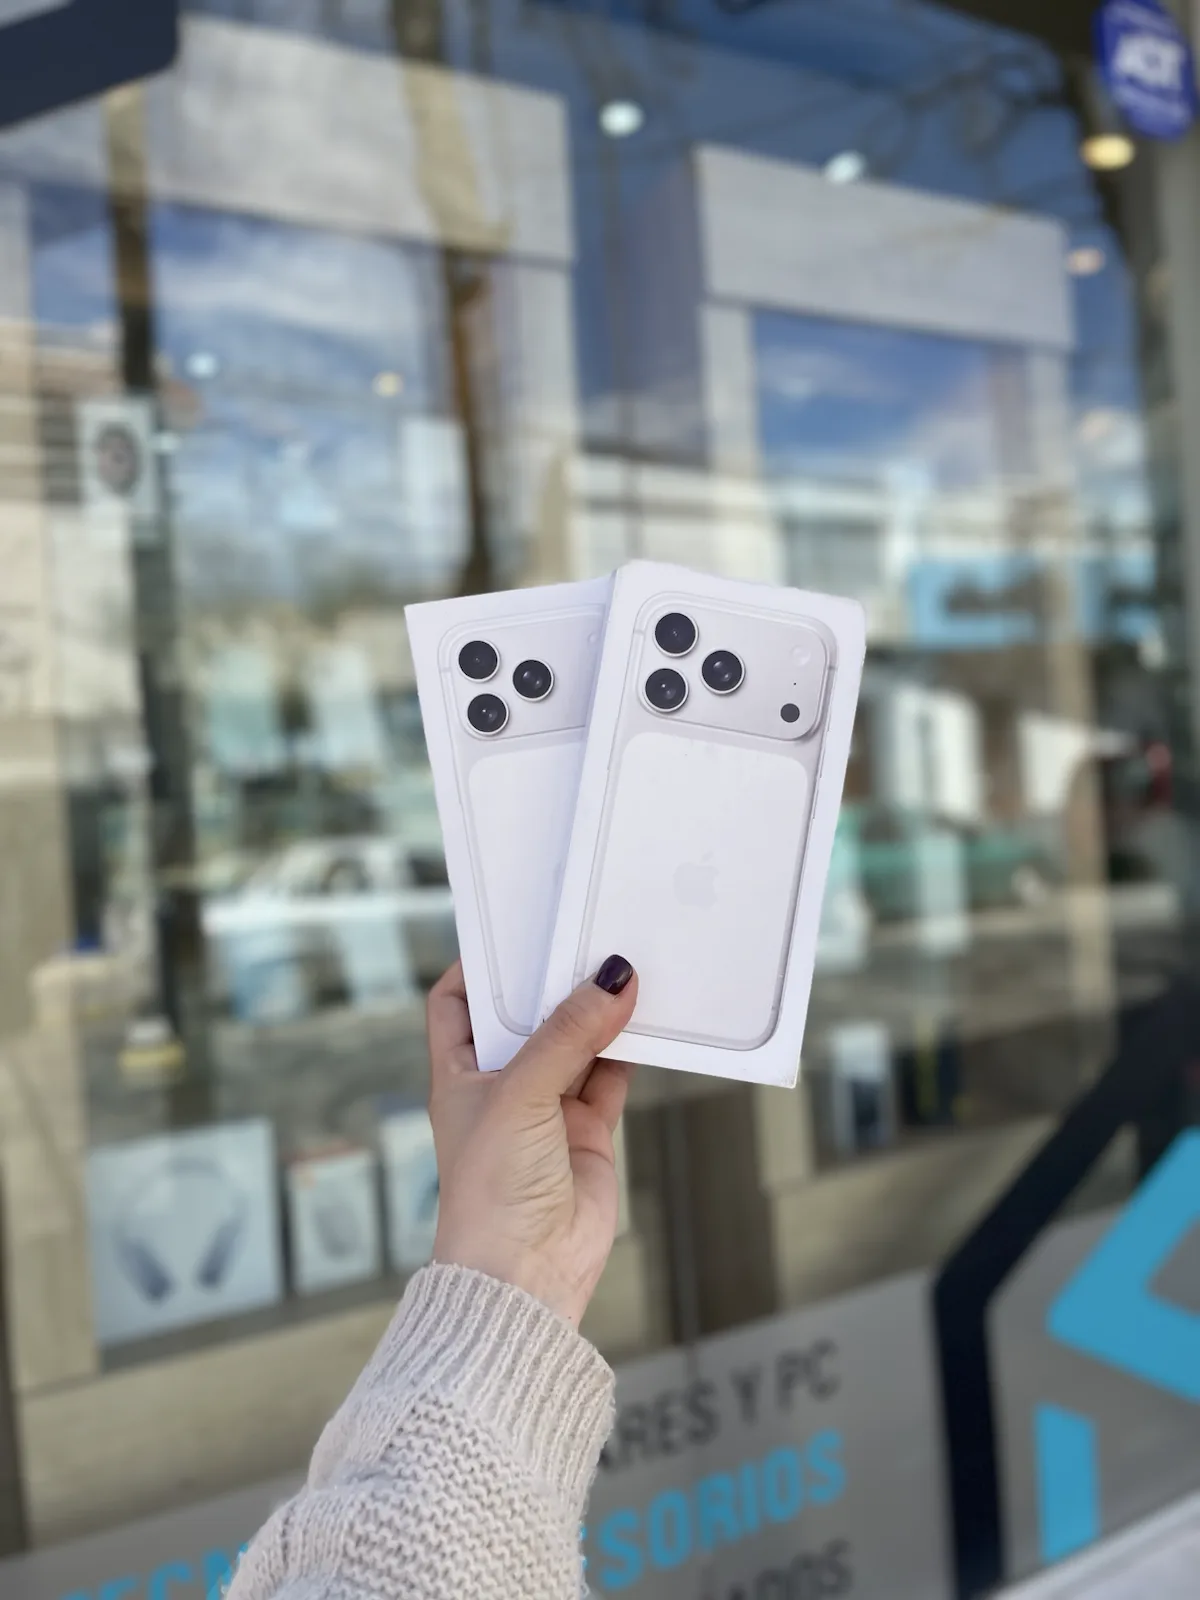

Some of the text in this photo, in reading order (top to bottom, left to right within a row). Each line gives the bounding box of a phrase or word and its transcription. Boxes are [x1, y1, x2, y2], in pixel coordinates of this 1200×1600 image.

[600, 1338, 839, 1472] RES Y PC
[580, 1429, 846, 1588] SORIOS
